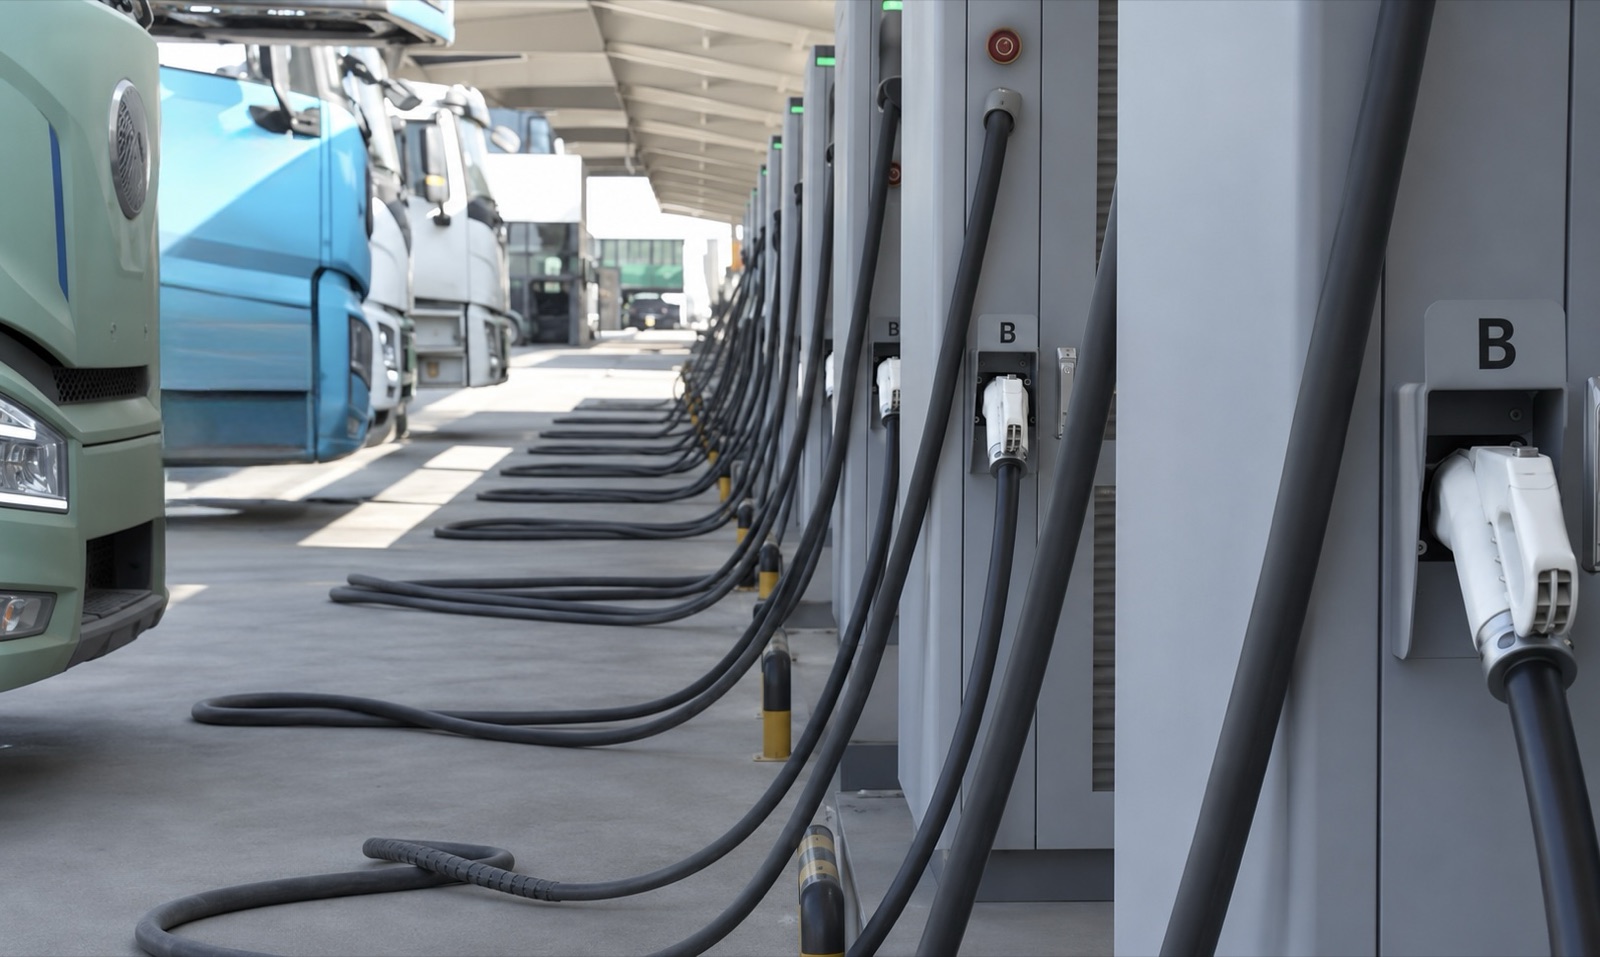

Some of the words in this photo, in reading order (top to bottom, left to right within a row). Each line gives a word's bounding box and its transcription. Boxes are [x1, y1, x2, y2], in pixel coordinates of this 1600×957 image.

[889, 321, 900, 336] B
[1000, 321, 1016, 343] B
[1479, 318, 1516, 369] B
